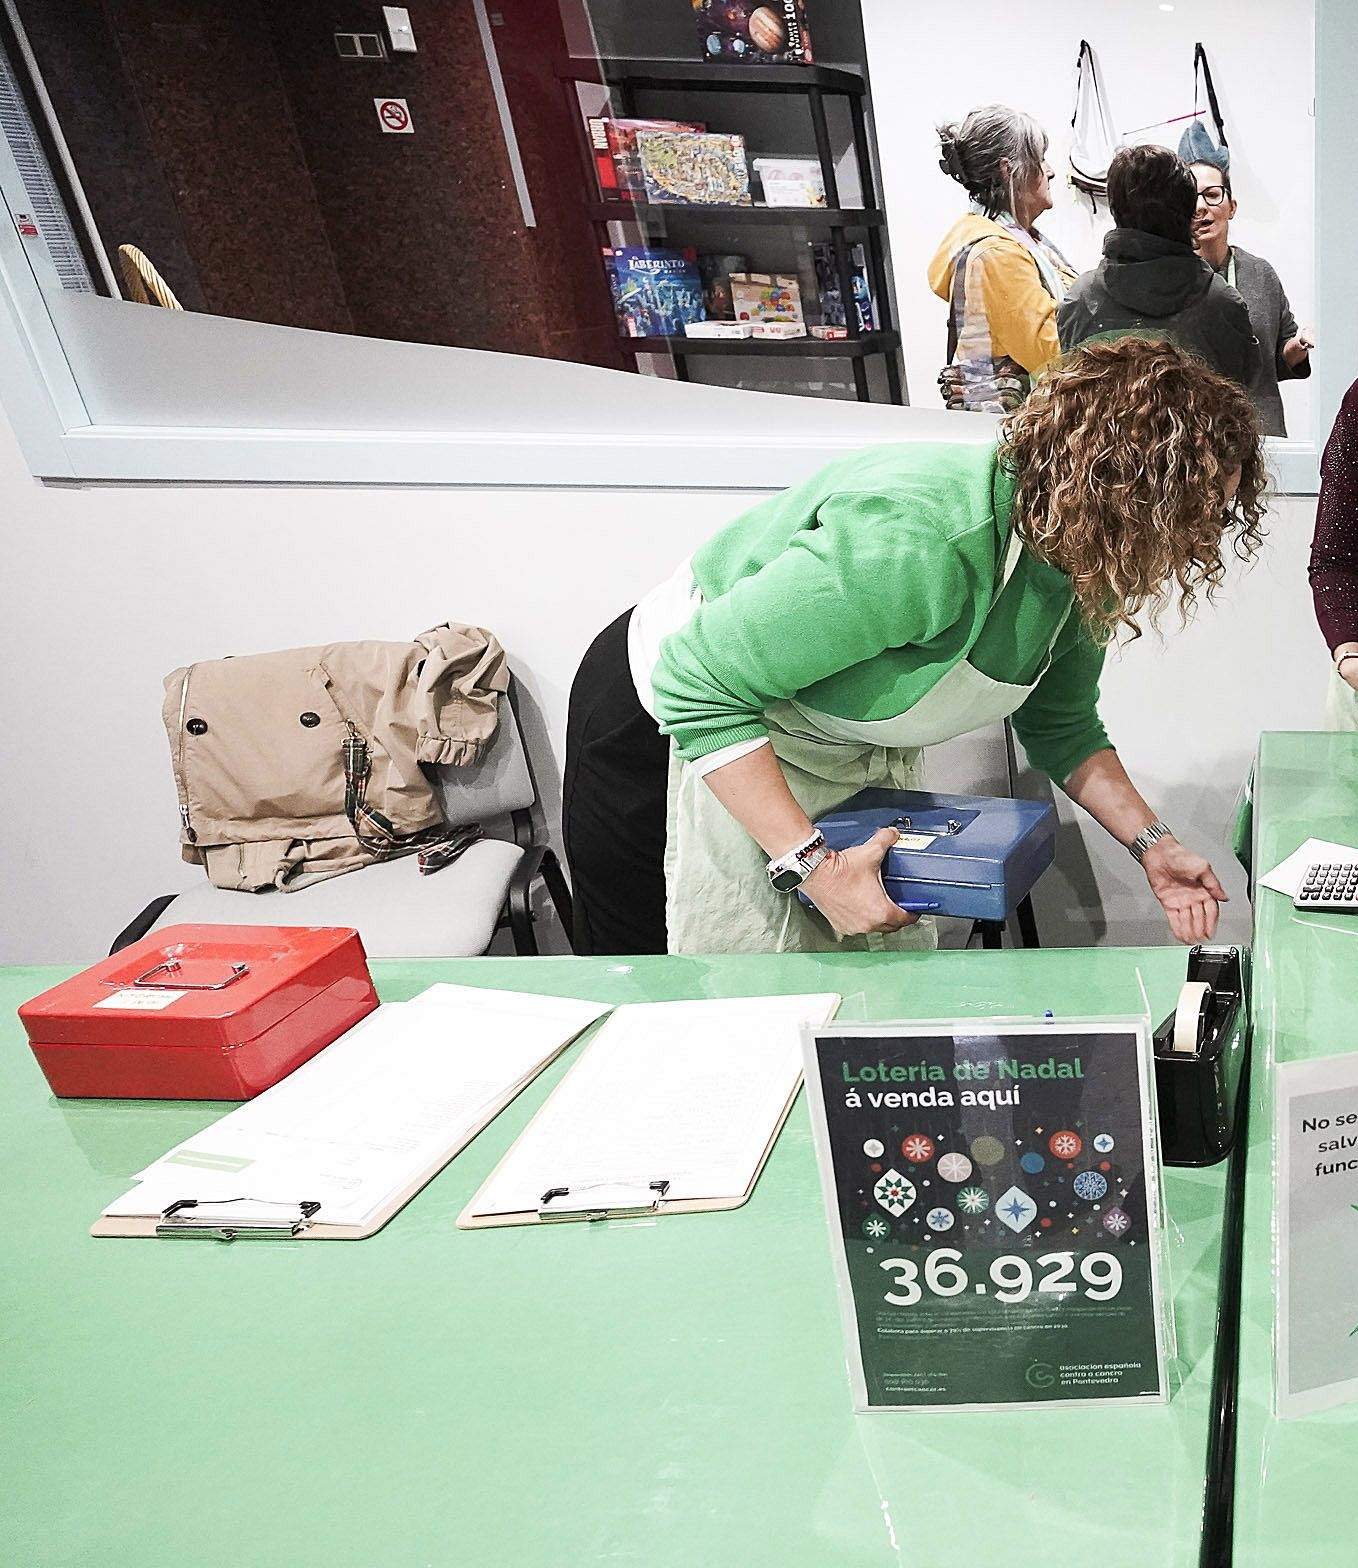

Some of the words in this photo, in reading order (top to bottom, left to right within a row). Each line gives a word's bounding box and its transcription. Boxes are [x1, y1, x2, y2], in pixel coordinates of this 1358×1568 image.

[952, 1060, 990, 1081] de
[996, 1057, 1085, 1080] Nadal
[867, 1086, 955, 1109] venda
[959, 1084, 1021, 1111] aquí
[1302, 1119, 1331, 1133] No
[1335, 1113, 1358, 1127] se
[879, 1247, 1123, 1307] 36.929
